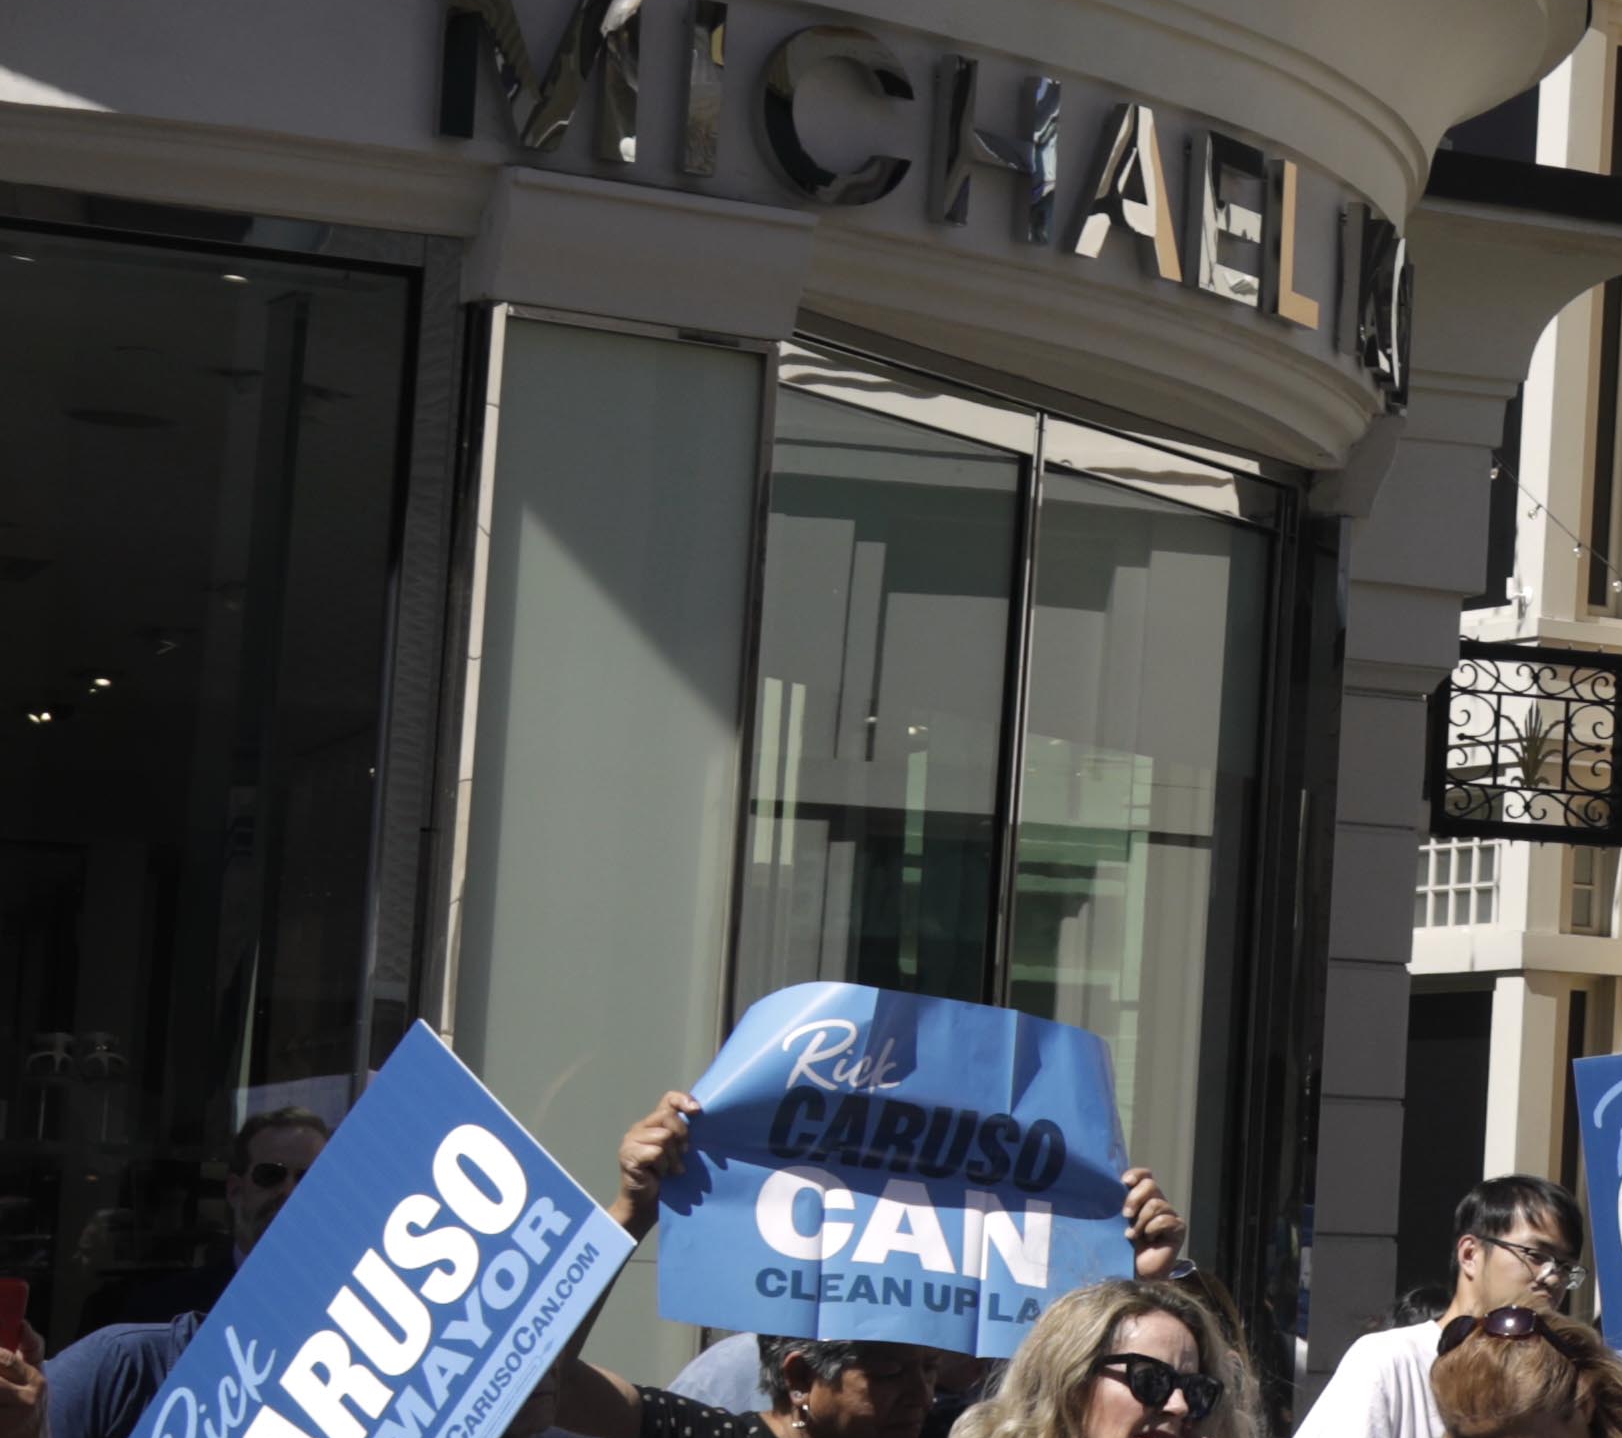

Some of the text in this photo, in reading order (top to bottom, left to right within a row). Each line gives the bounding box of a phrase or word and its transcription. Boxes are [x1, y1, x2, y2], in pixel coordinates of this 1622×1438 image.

[781, 1018, 901, 1094] Rick
[768, 1087, 1066, 1192] CARUSO
[755, 1168, 1053, 1289] CAN
[755, 1267, 917, 1313] CLEAN
[924, 1272, 981, 1319] UP
